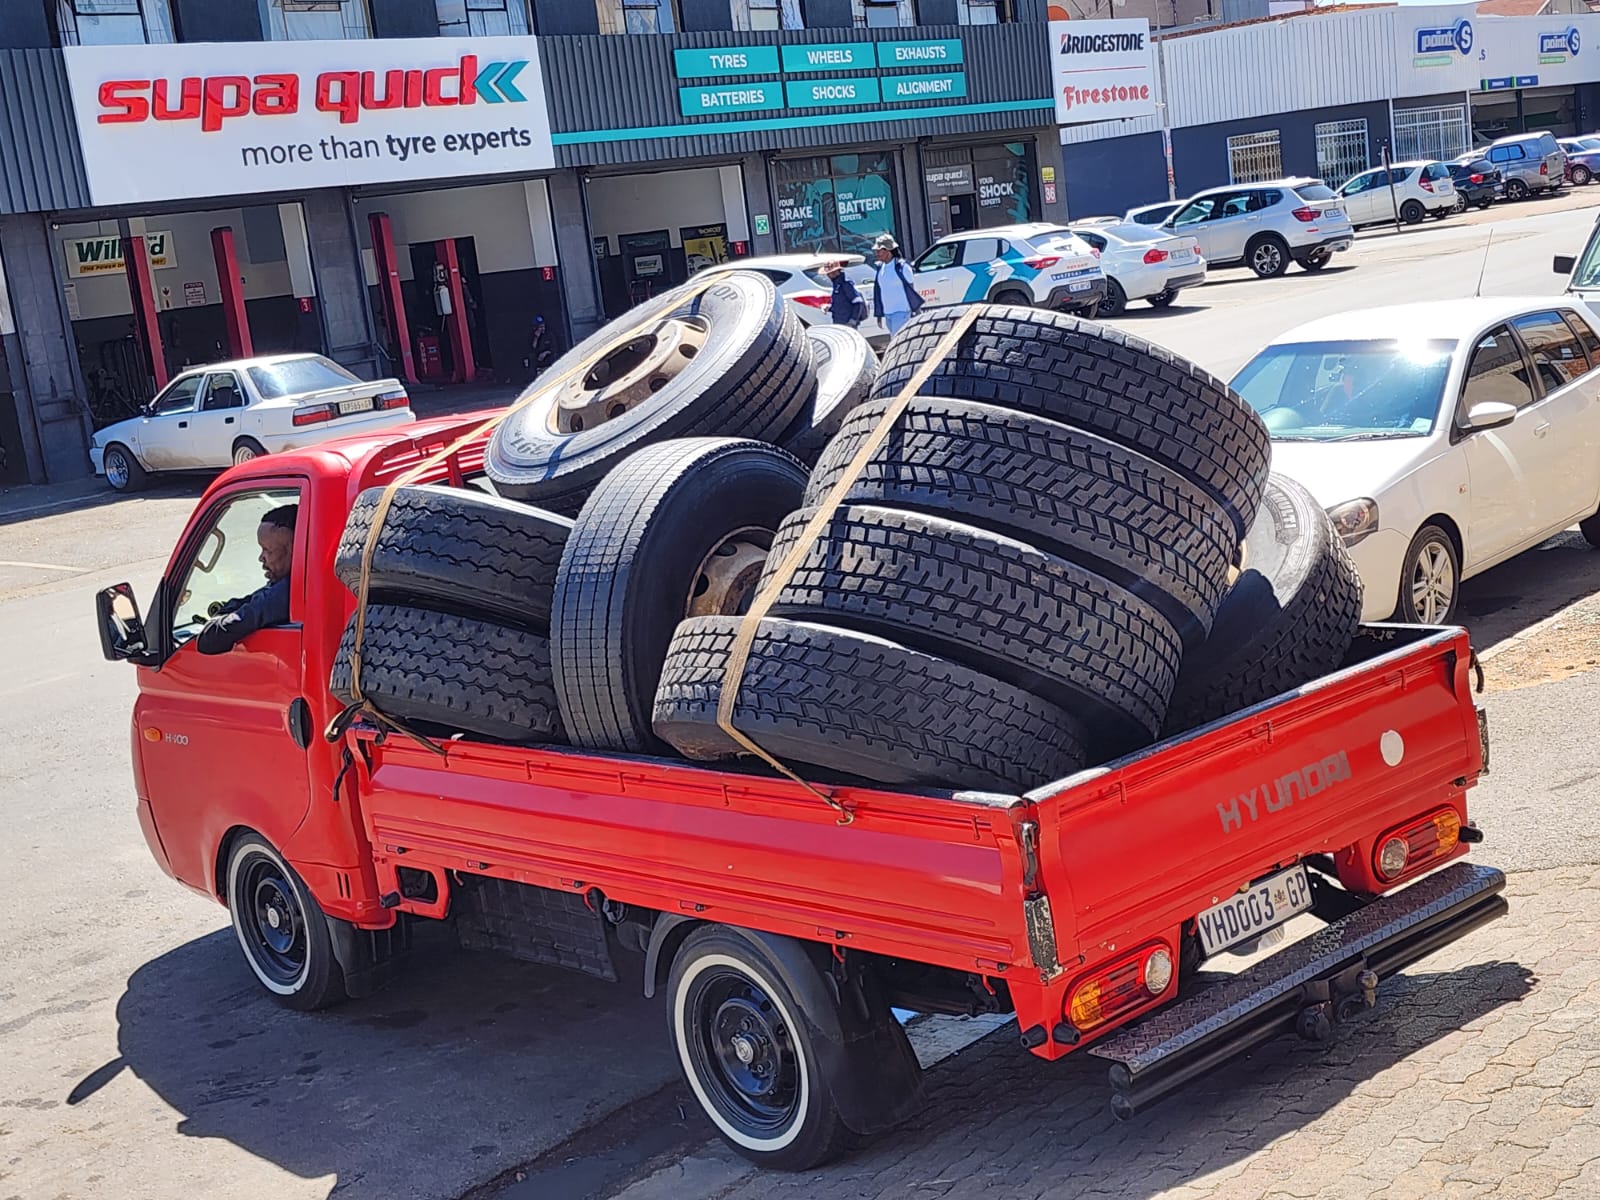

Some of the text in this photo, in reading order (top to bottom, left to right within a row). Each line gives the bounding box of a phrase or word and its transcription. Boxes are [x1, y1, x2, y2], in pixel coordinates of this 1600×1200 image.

[1060, 33, 1145, 54] BRIDGESTONE
[709, 54, 748, 69] TYRES
[807, 49, 853, 64] WHEELS
[895, 46, 947, 61] EXHAUSTS
[812, 84, 856, 100] SHOCKS
[896, 79, 953, 96] ALIGNMENT
[97, 73, 300, 132] supa
[701, 89, 765, 108] BATTERIES
[1063, 84, 1150, 111] Firestone
[241, 127, 532, 166] more than tyre experts
[838, 192, 853, 200] YOUR
[980, 182, 1015, 198] SHOCK
[838, 196, 886, 215] BATTERY
[75, 235, 165, 263] Willd
[1216, 750, 1352, 833] HYUNDAI
[1199, 871, 1307, 948] YHD003 GP
